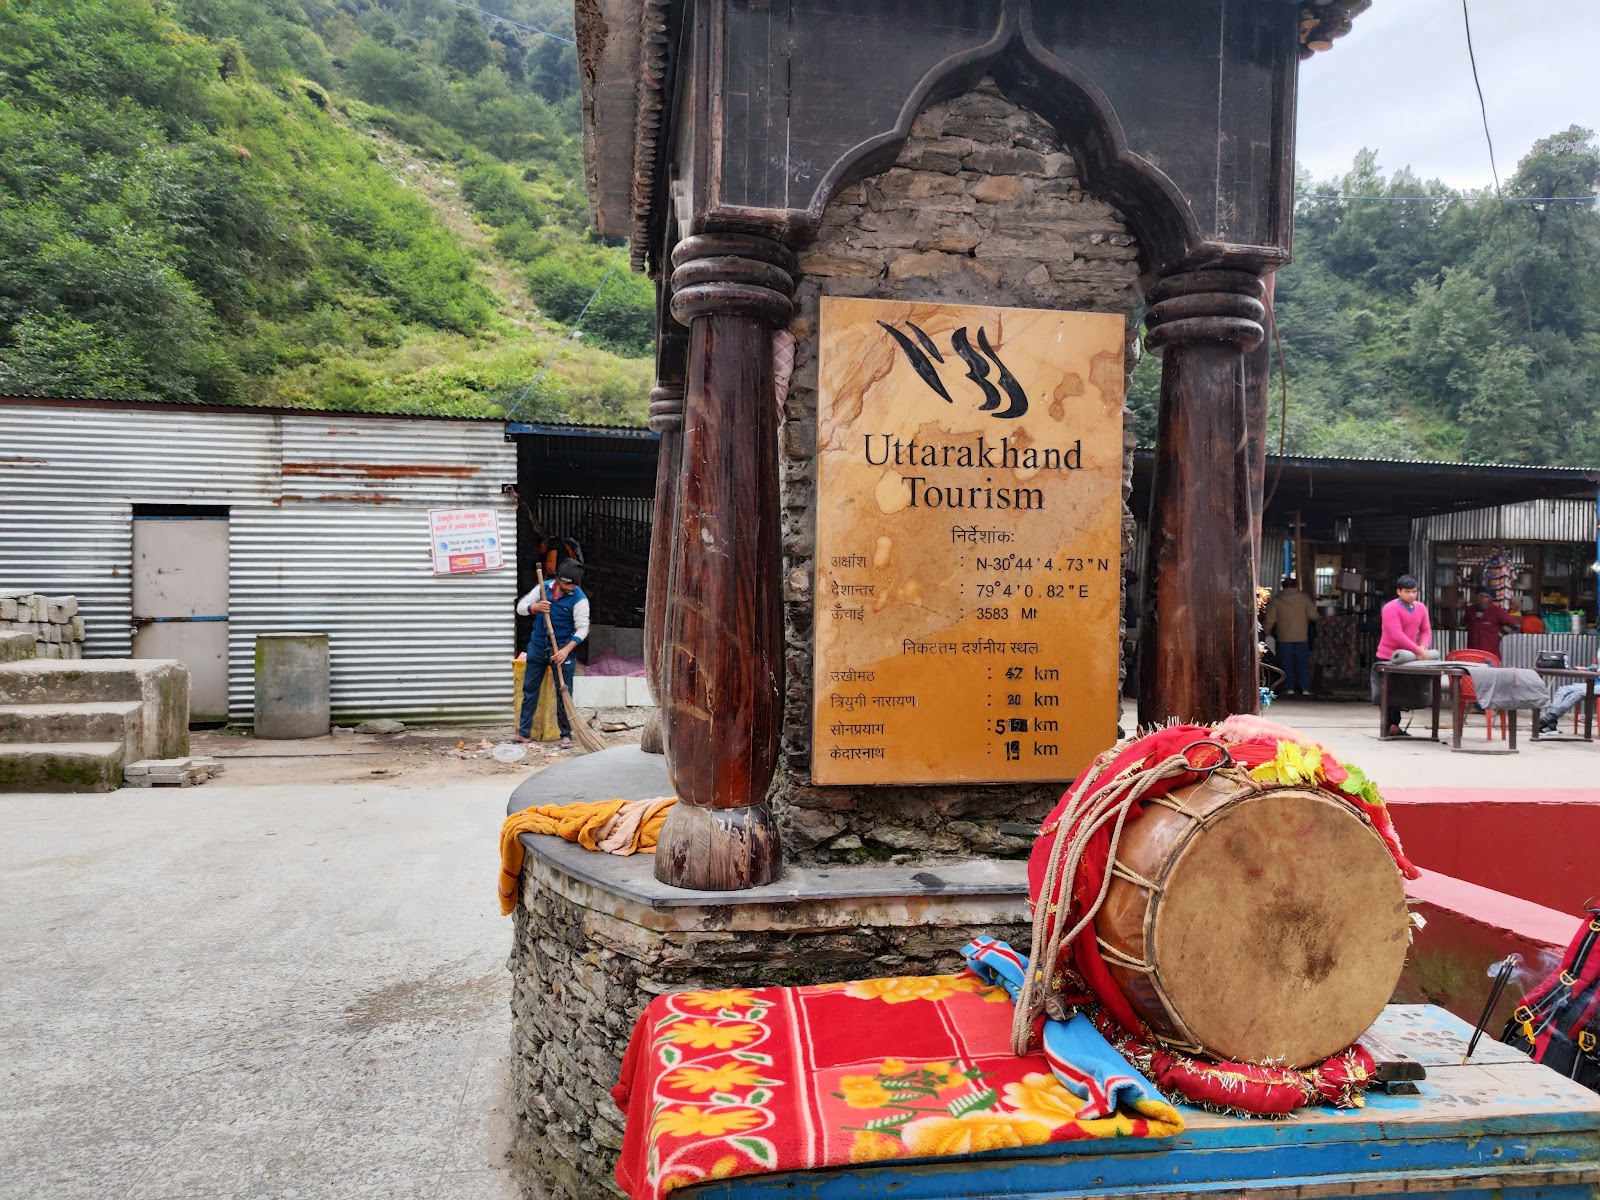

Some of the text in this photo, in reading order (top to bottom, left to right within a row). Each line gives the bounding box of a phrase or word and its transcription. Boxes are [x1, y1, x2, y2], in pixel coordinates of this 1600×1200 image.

[863, 433, 1084, 471] Uttarakhand
[901, 476, 1046, 510] Tourism
[830, 553, 867, 569] अक्षांश
[831, 580, 875, 597] देशान्तर
[831, 603, 865, 622] ऊँचाई
[976, 607, 1009, 620] 3583
[1021, 607, 1038, 620] Mt
[902, 638, 1039, 655] निकटतम दर्शनीय स्थल
[830, 667, 875, 682] उखीमठ
[1034, 665, 1059, 681] km
[830, 692, 867, 712] त्रियुगी
[1034, 691, 1059, 707] km
[830, 721, 885, 736] सोनप्रयाग
[1034, 717, 1058, 732] km
[829, 745, 885, 760] केदारनाथ
[1034, 741, 1058, 756] km
